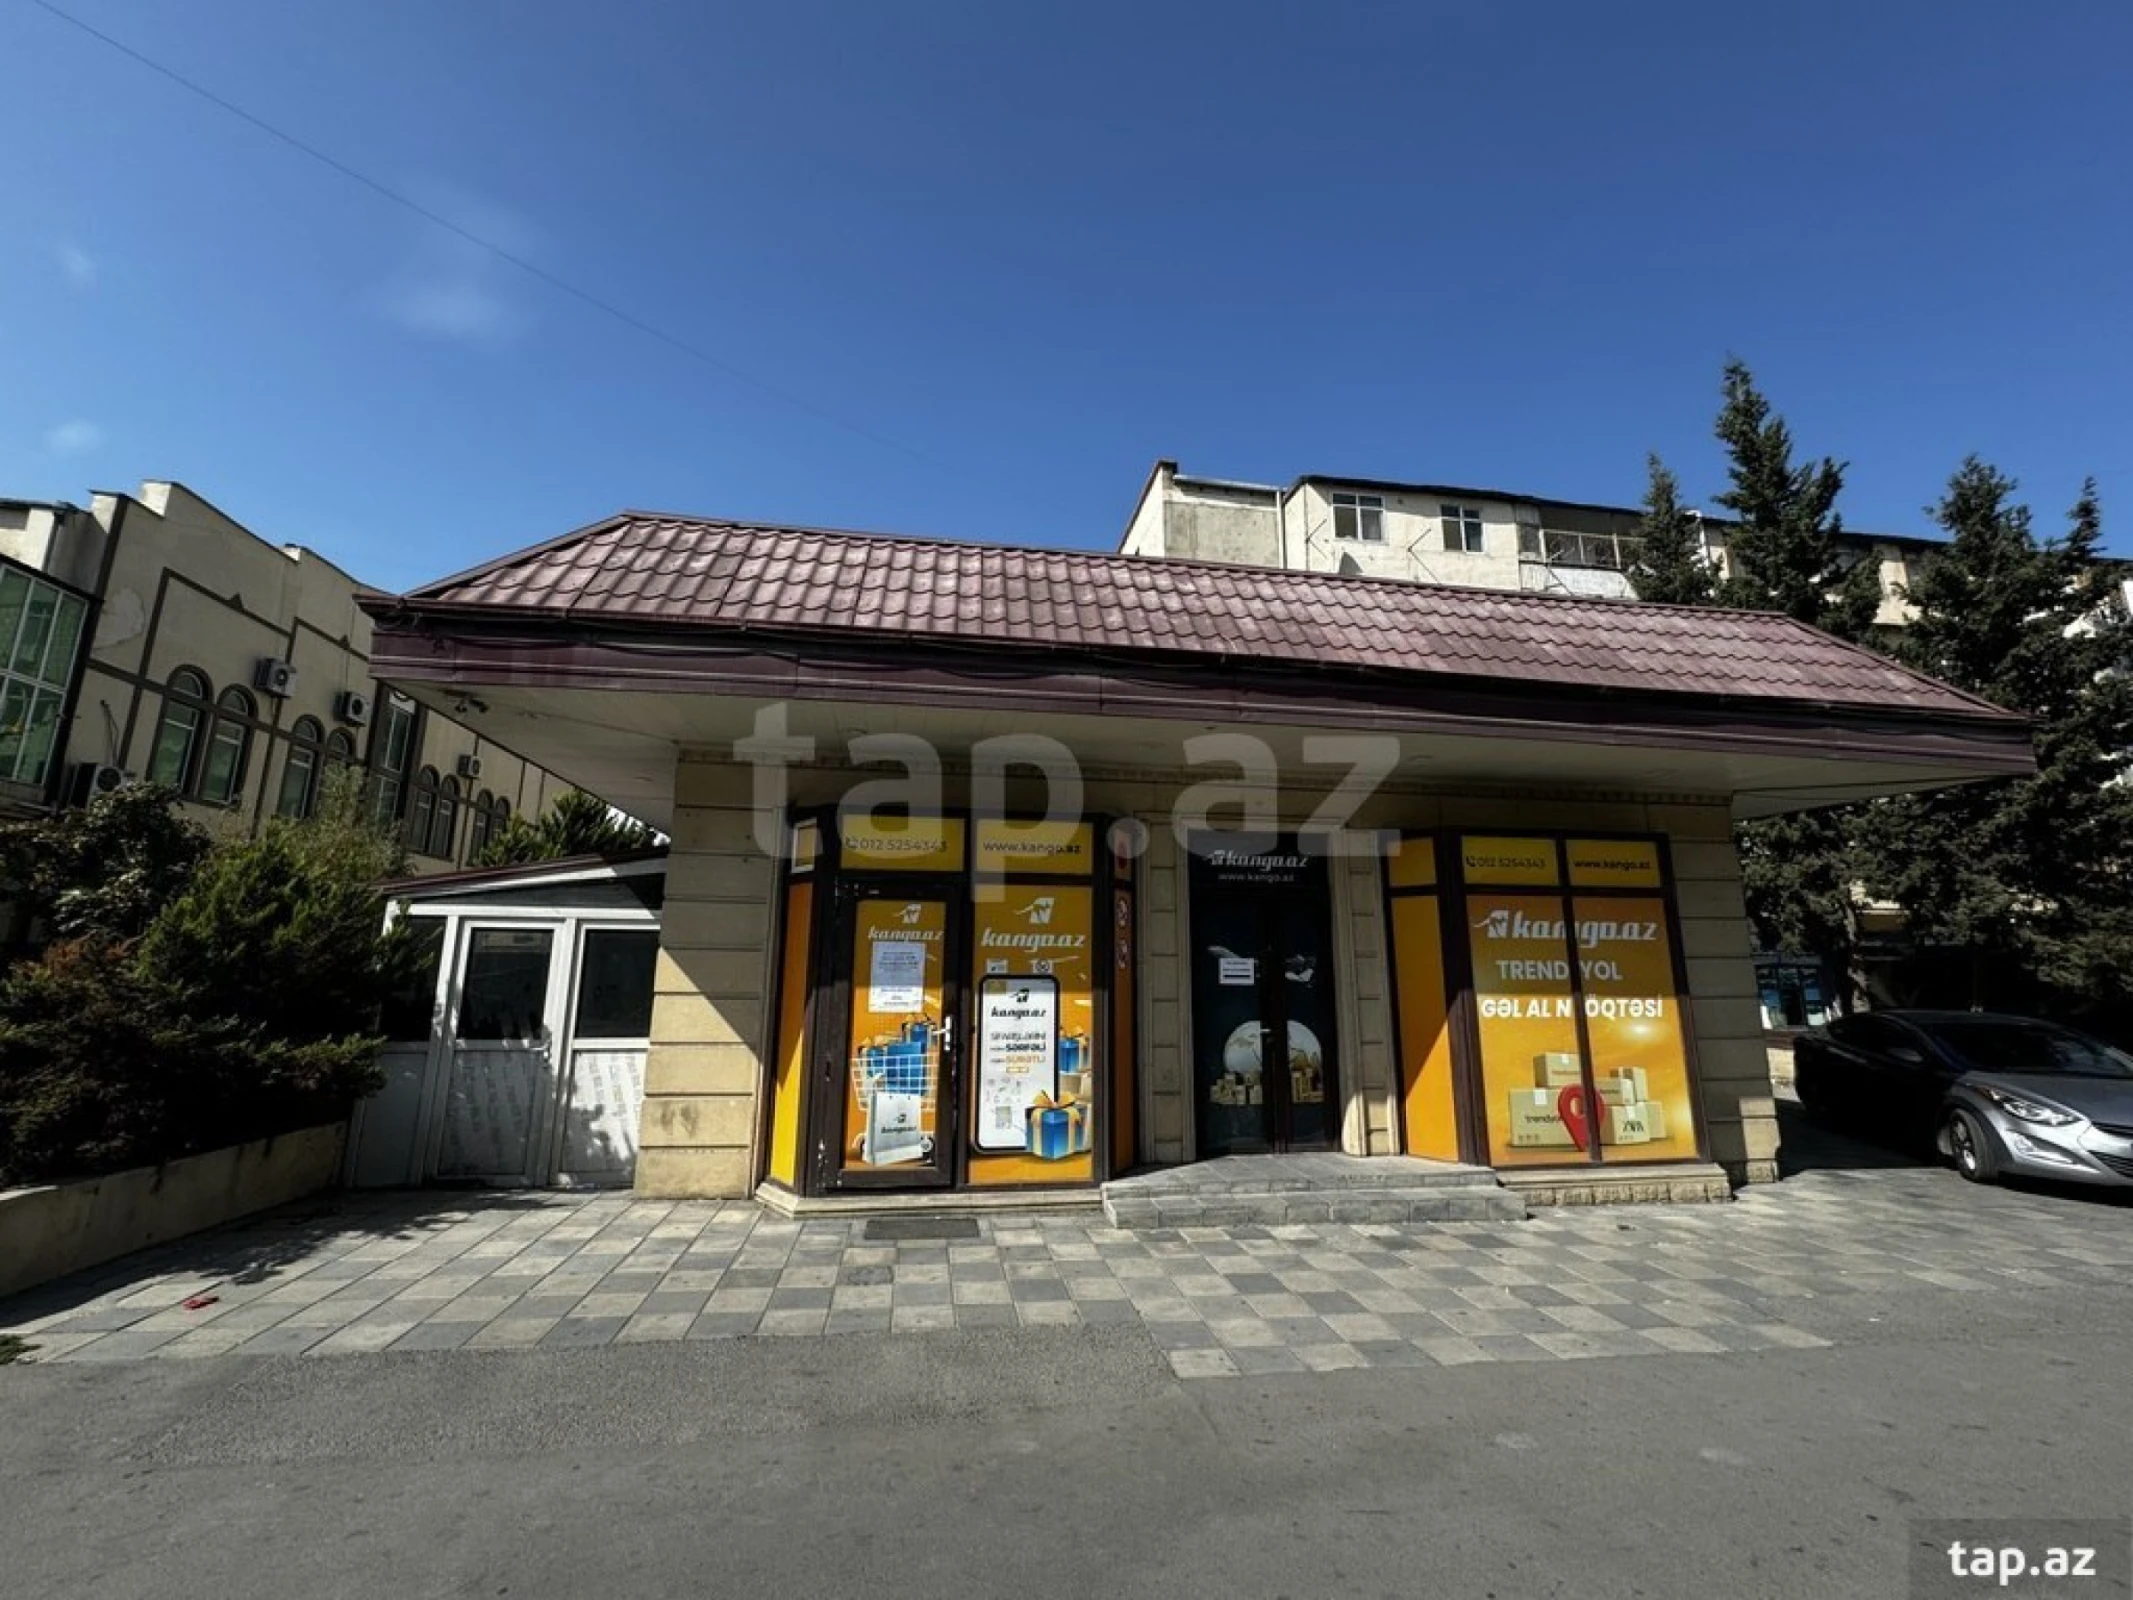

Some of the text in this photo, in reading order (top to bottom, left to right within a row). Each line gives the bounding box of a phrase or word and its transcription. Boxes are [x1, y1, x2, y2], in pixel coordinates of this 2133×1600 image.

[860, 839, 882, 851] 012
[982, 841, 1082, 856] www.kango.az
[1573, 858, 1652, 872] www.kango.az
[980, 926, 1086, 953] kango.az
[1481, 998, 1523, 1018] GƏL
[1525, 998, 1551, 1018] AL
